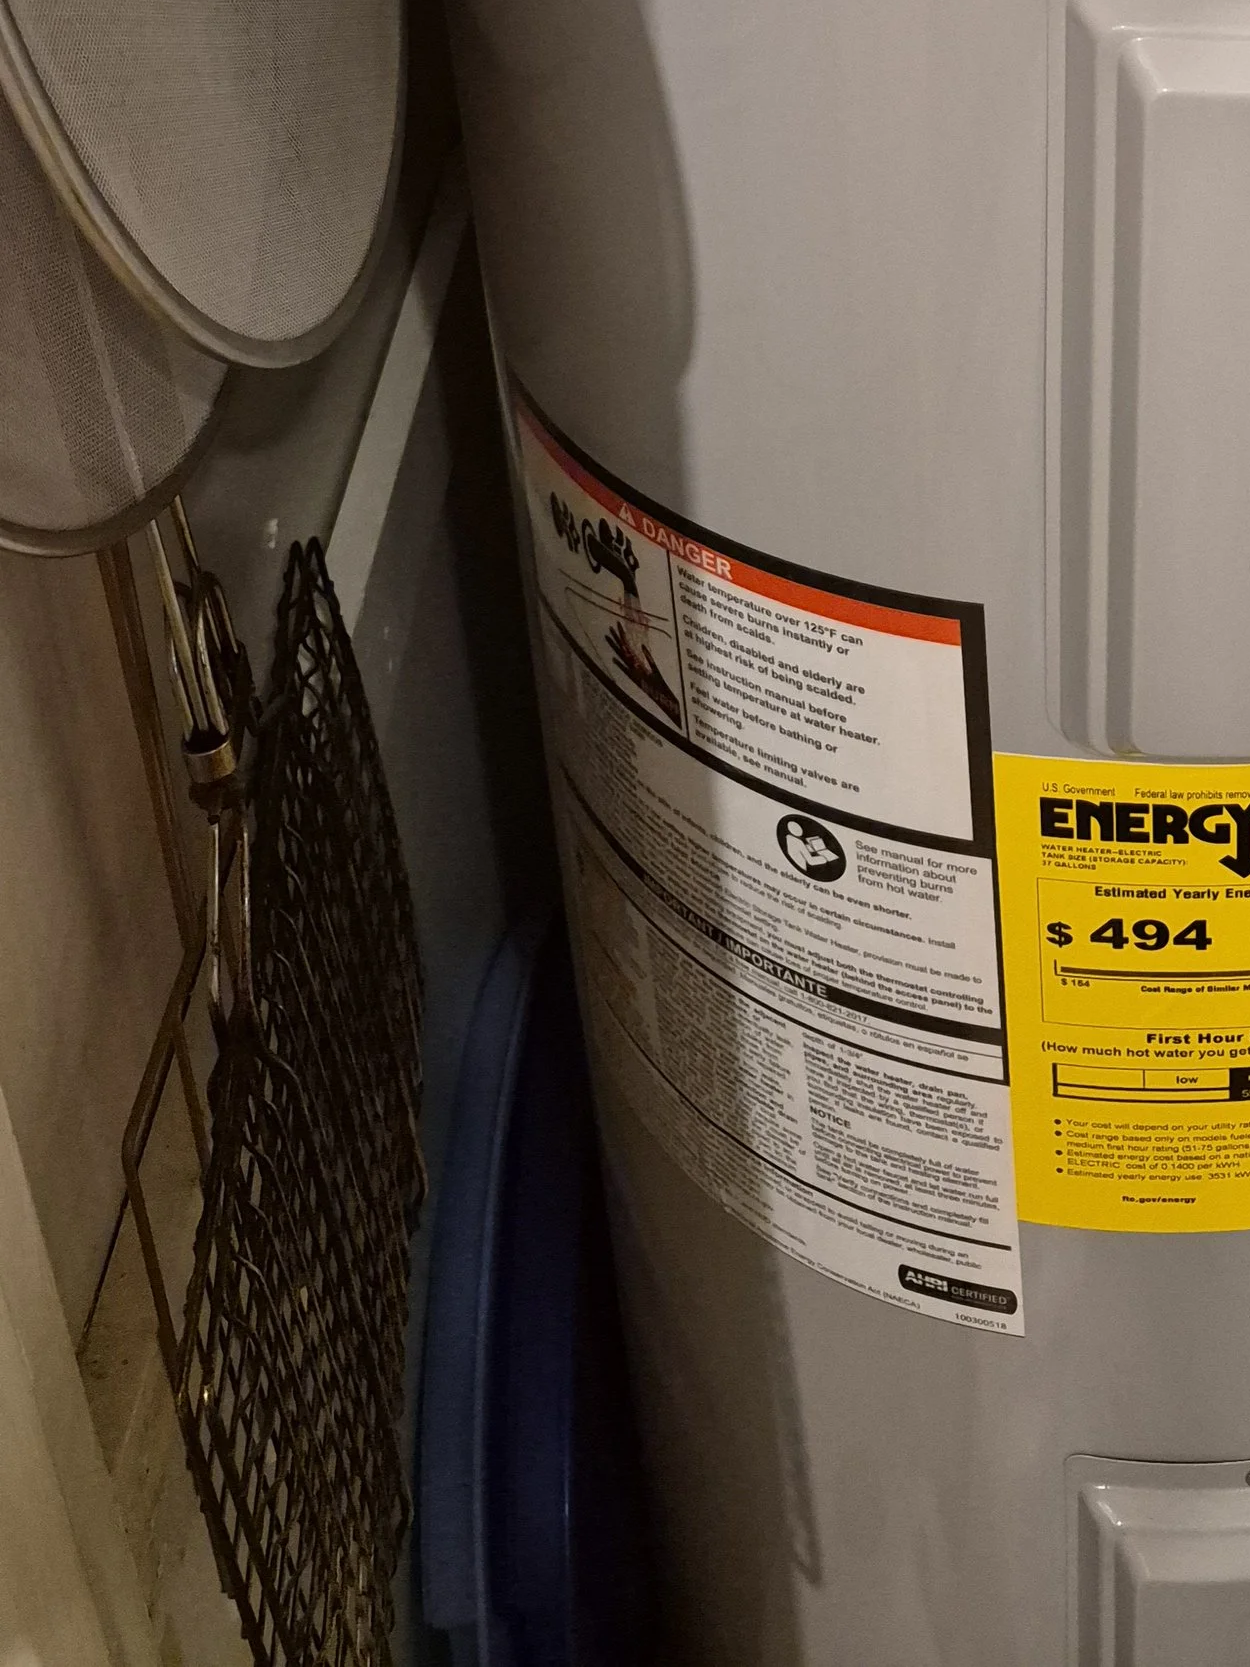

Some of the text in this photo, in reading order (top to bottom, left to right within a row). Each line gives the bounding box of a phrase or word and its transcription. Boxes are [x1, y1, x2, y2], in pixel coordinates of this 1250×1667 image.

[642, 517, 733, 581] DANGER
[676, 564, 864, 646] Water temperature over 125°F can
[679, 581, 849, 656] cause severe burns instantly or
[680, 594, 775, 646] death from scalds.
[682, 614, 865, 694] Children, disabled and elderly are
[684, 629, 857, 705] at highest risk of being scalded.
[686, 649, 847, 723] See instruction manual before
[688, 663, 880, 745] setting temperature at water heater.
[690, 681, 838, 753] Feel water before bathing or
[691, 697, 745, 730] showering.
[693, 714, 860, 792] Temperature limiting valves are
[695, 729, 807, 787] available, see manual.
[1064, 784, 1115, 796] Government
[1135, 788, 1167, 798] Federal
[1170, 791, 1183, 799] law
[1187, 791, 1223, 800] prohibits
[855, 839, 978, 875] See manual for more
[856, 852, 957, 883] information about
[857, 864, 954, 894] preventing burns
[857, 874, 942, 903] from hot water.
[1095, 886, 1166, 899] Estimated
[1173, 888, 1219, 901] Yearly
[1046, 918, 1212, 951] $ 494
[724, 936, 828, 998] IMPORTANTE
[1041, 1041, 1077, 1053] (How
[1082, 1047, 1121, 1057] much
[1127, 1048, 1149, 1057] hot
[1153, 1049, 1194, 1057] water
[1198, 1048, 1224, 1060] you
[1147, 1034, 1191, 1044] First
[1198, 1033, 1244, 1044] Hour
[1176, 1070, 1198, 1084] low
[809, 1106, 851, 1129] NOTICE
[951, 1286, 1008, 1305] CERTIFIED
